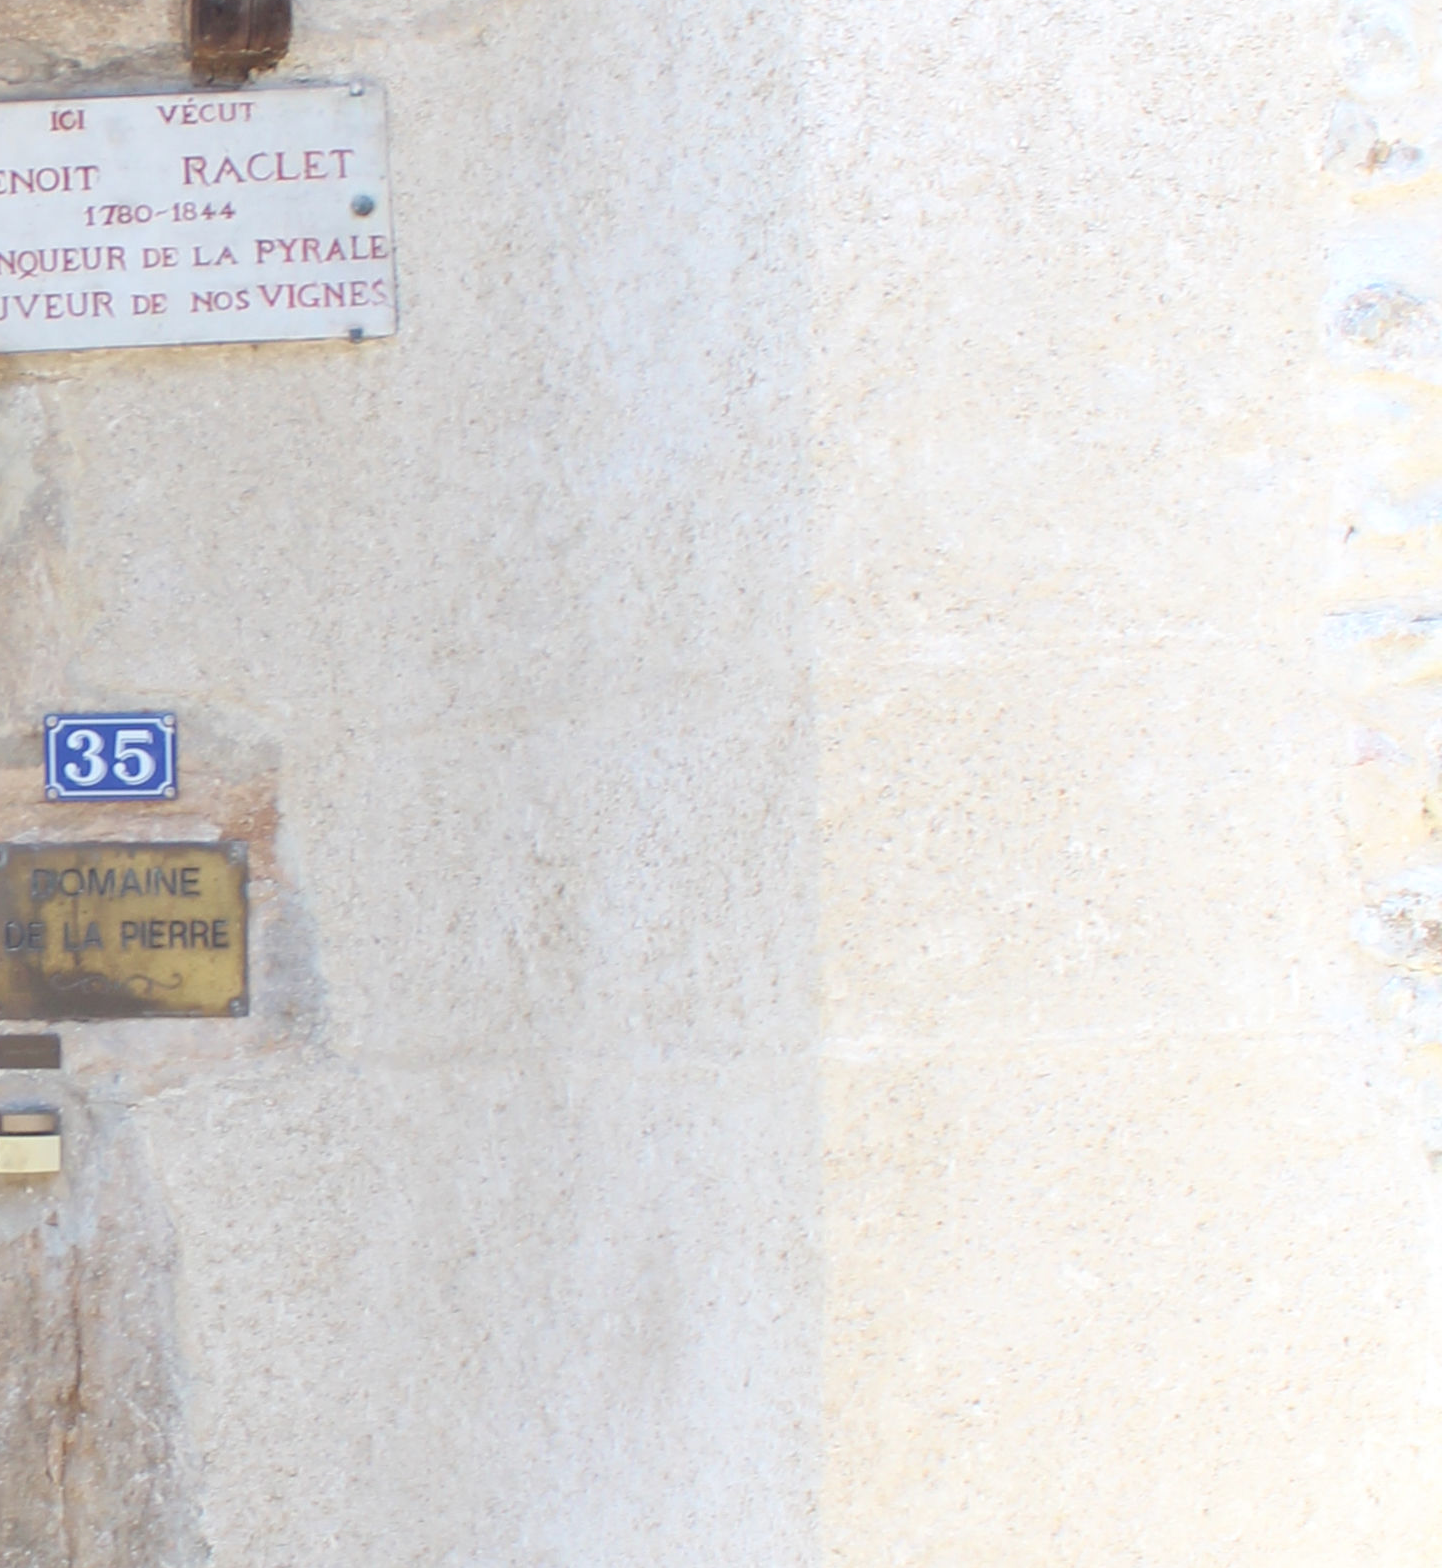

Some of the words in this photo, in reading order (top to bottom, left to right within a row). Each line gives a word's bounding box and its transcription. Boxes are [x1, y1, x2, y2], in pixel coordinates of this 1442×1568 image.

[49, 109, 85, 131] ICI
[156, 98, 256, 124] VÉCUT
[182, 149, 355, 186] RACLET
[84, 201, 236, 226] 1780-1844
[142, 247, 178, 268] DE
[192, 245, 239, 267] LA
[254, 235, 389, 264] PYRALE
[130, 293, 168, 315] DE
[190, 288, 251, 313] NOS
[257, 278, 389, 309] VIGNES
[63, 729, 157, 785] 35
[30, 867, 202, 901] DOMAINE
[3, 920, 45, 952] DE
[63, 920, 103, 952] LA
[121, 918, 231, 951] PIERRE
